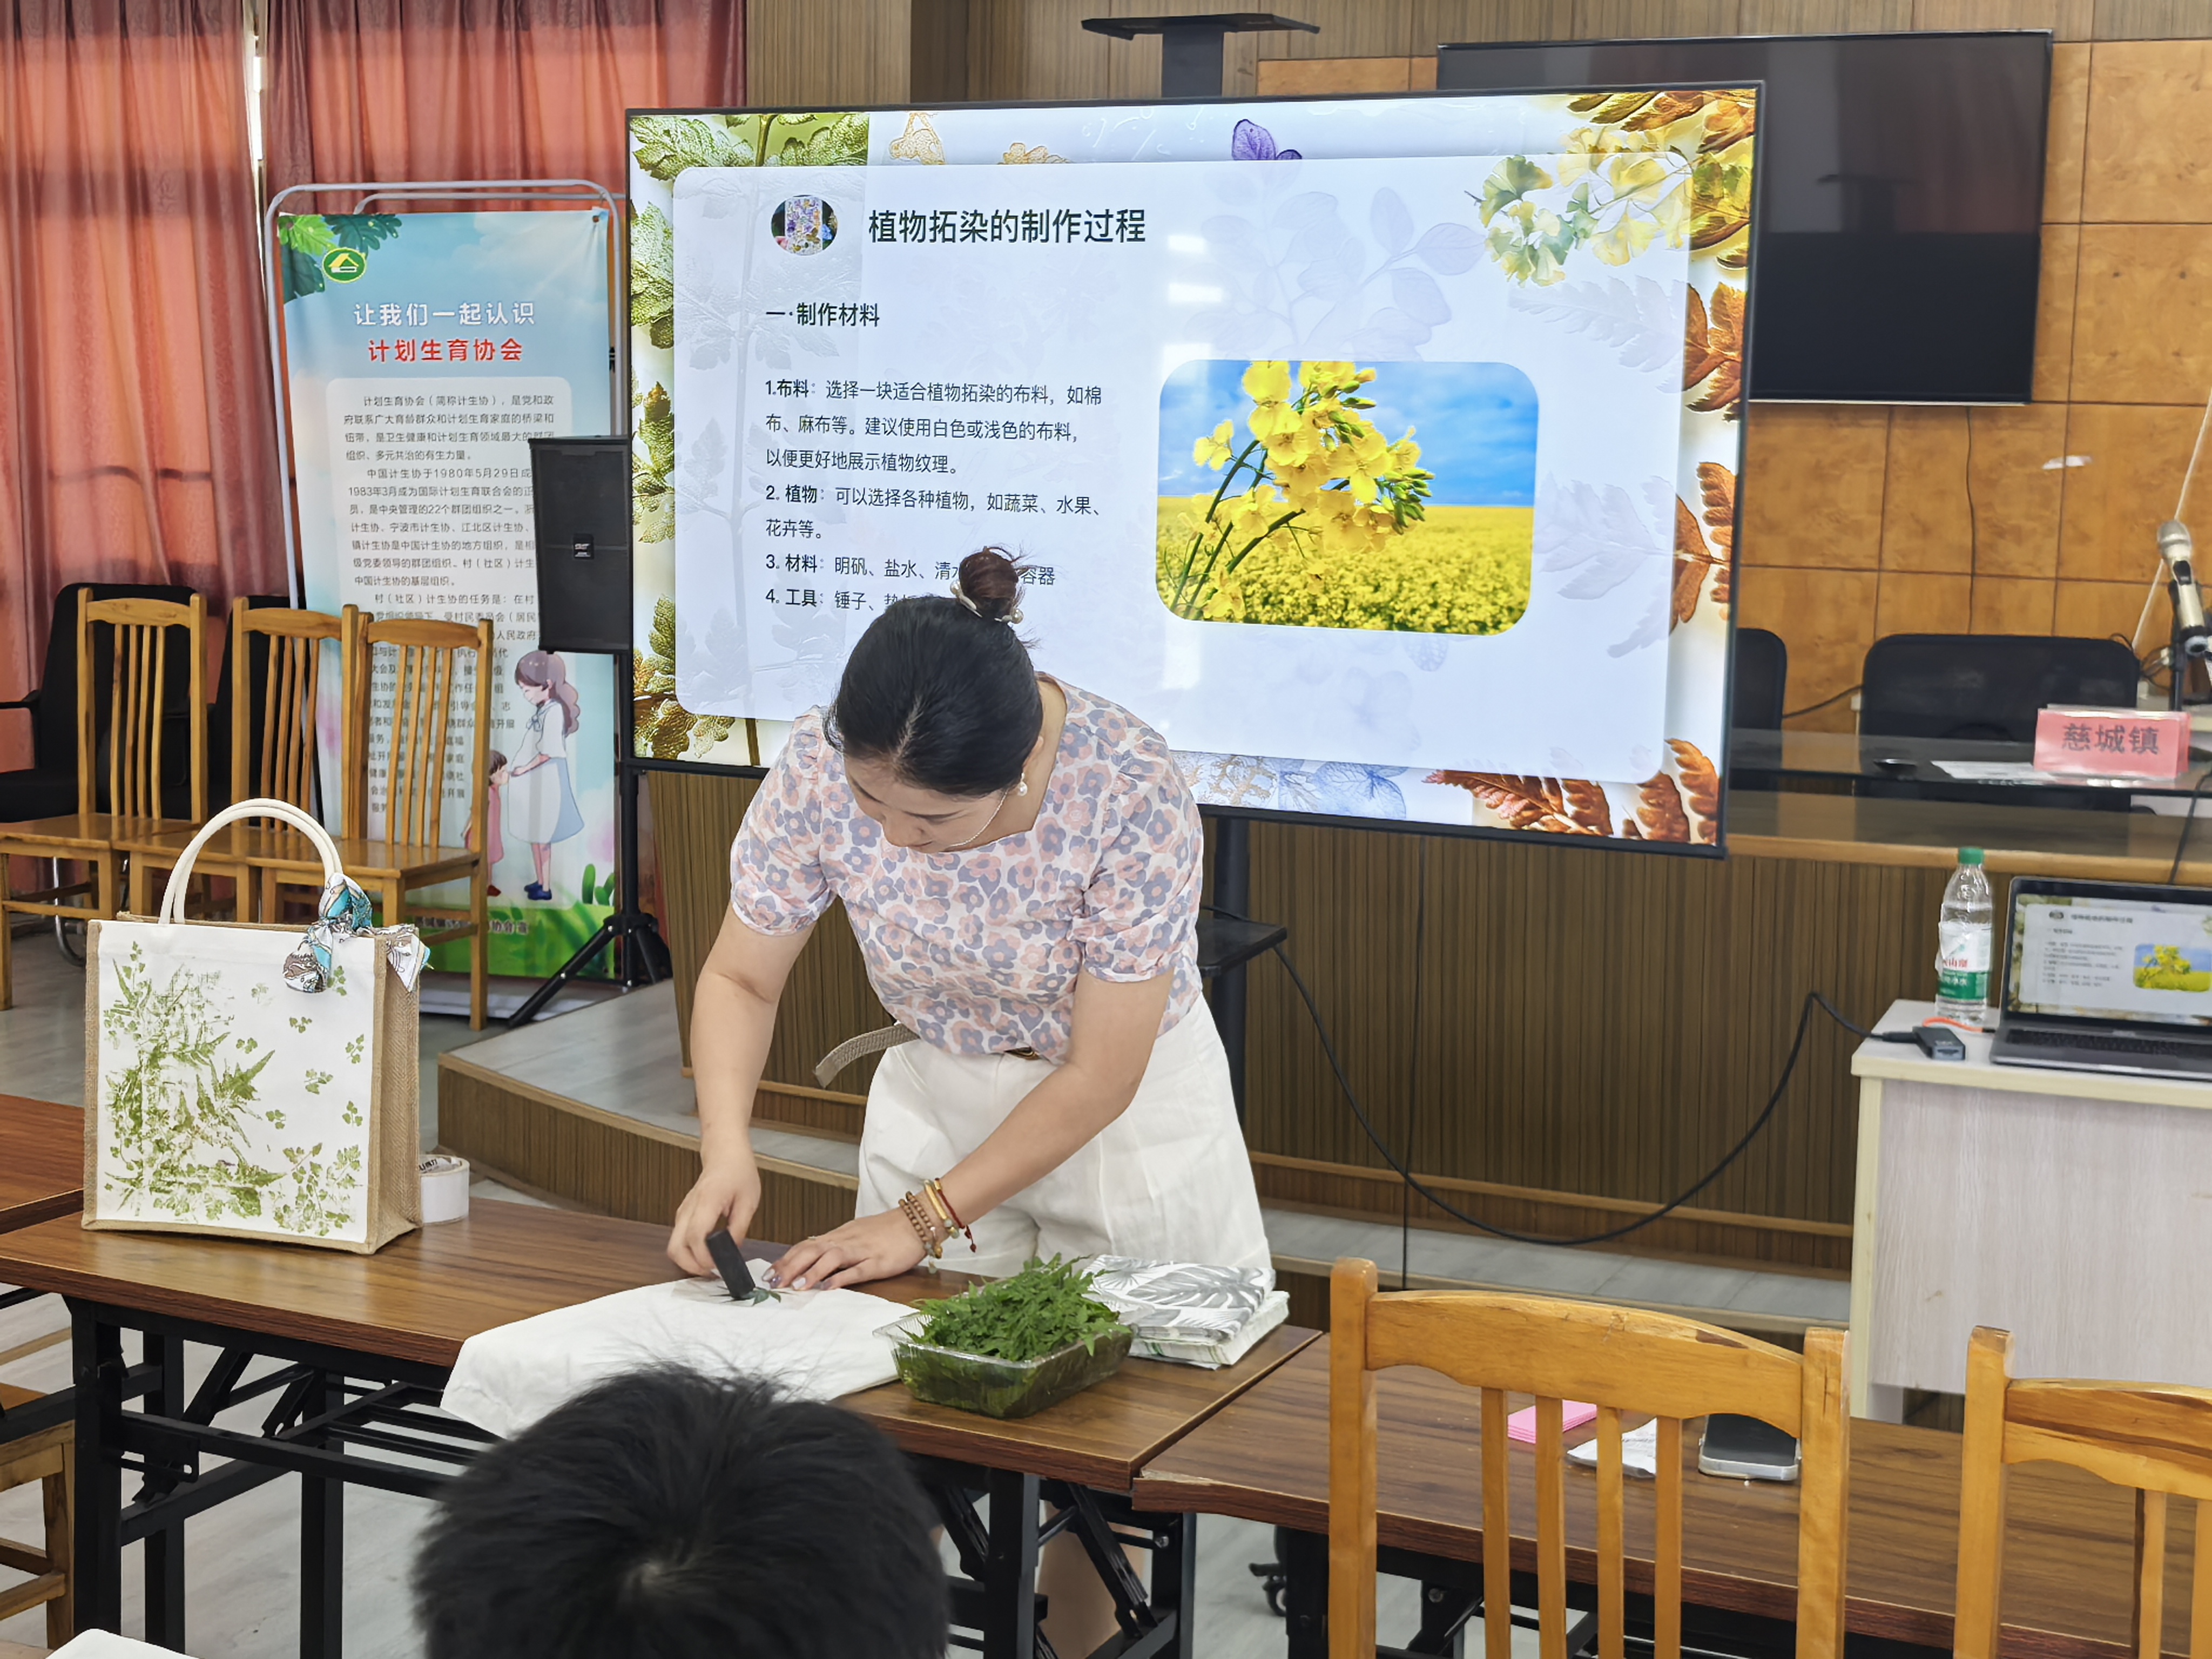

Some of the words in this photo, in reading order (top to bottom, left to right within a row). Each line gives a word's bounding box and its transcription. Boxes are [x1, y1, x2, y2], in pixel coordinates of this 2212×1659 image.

[868, 209, 1146, 244] 植物拓染的制作过程
[354, 301, 535, 326] 让我们一起认识
[368, 338, 523, 362] 计划生育协会
[766, 448, 957, 475] 以便更好地展示植物纹理。
[766, 518, 821, 539] 花卉等。
[2061, 722, 2160, 756] 慈城镇
